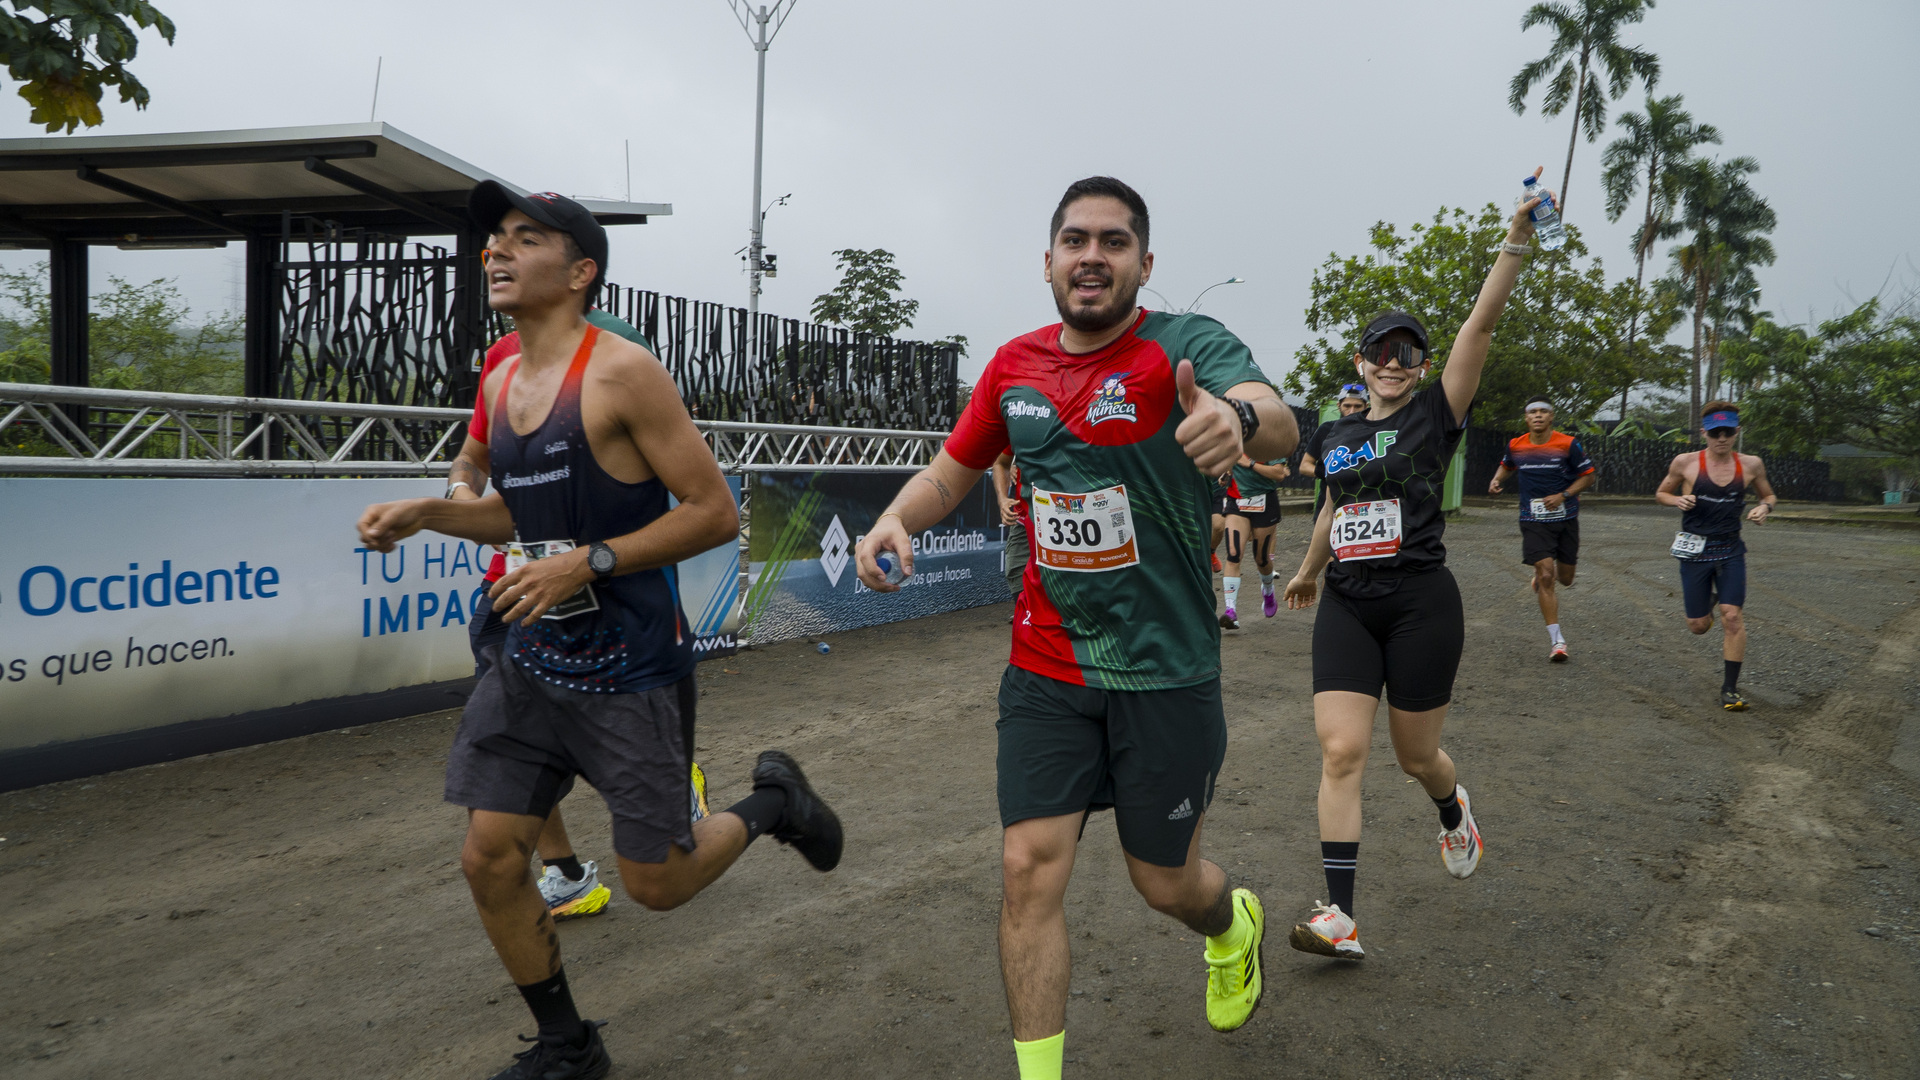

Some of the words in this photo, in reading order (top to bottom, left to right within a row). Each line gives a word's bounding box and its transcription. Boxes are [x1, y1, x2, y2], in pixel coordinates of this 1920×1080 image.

[1085, 402, 1136, 423] Muñeca
[922, 529, 984, 556] Occidente
[1048, 517, 1102, 547] 330
[1336, 518, 1387, 544] 1524
[19, 559, 280, 617] Occidente
[926, 570, 943, 587] que
[945, 565, 972, 582] hacen.
[692, 634, 736, 652] AVAL
[41, 649, 113, 686] que
[125, 636, 236, 669] hacen.
